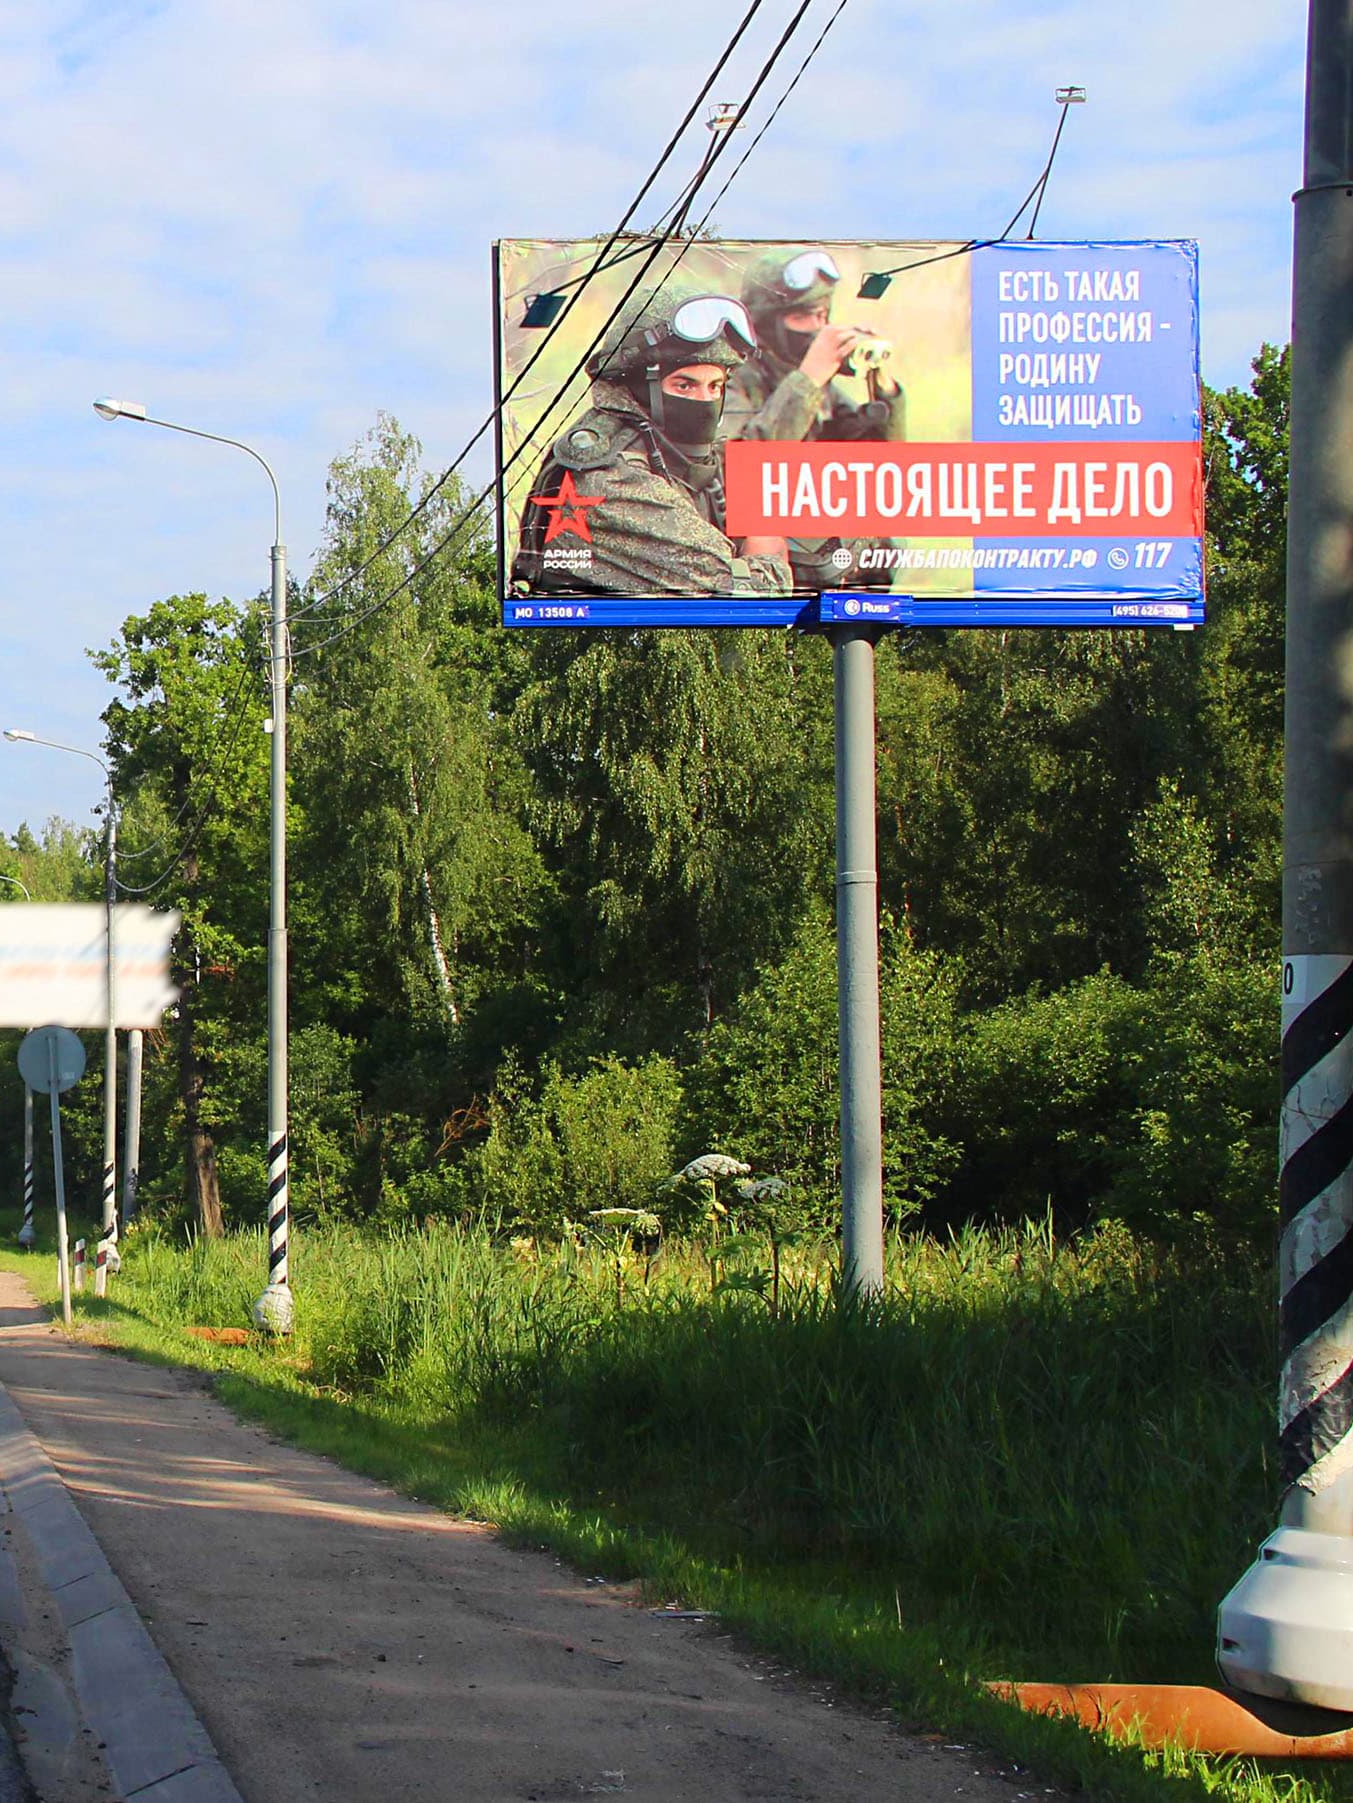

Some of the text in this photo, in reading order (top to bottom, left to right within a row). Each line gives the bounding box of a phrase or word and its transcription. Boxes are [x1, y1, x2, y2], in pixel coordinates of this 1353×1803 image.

[999, 271, 1140, 302] ЕСТЬ ТАКАЯ
[999, 312, 1152, 343] ПРОФЕССИЯ
[999, 353, 1101, 388] РОДИНУ
[998, 394, 1142, 429] ЗАЩИЩАТЬ
[761, 462, 1174, 524] НАСТОЯЩЕЕ ДЕЛО
[543, 549, 592, 559] АРМИЯ
[543, 560, 592, 569] РОССИИ
[858, 548, 1098, 570] СЛУЖБАПОКОНТРАКТУ.РФ
[1134, 542, 1174, 569] 117
[539, 608, 573, 618] 13508
[862, 602, 890, 613] Russ
[1141, 605, 1188, 618] 626-52
